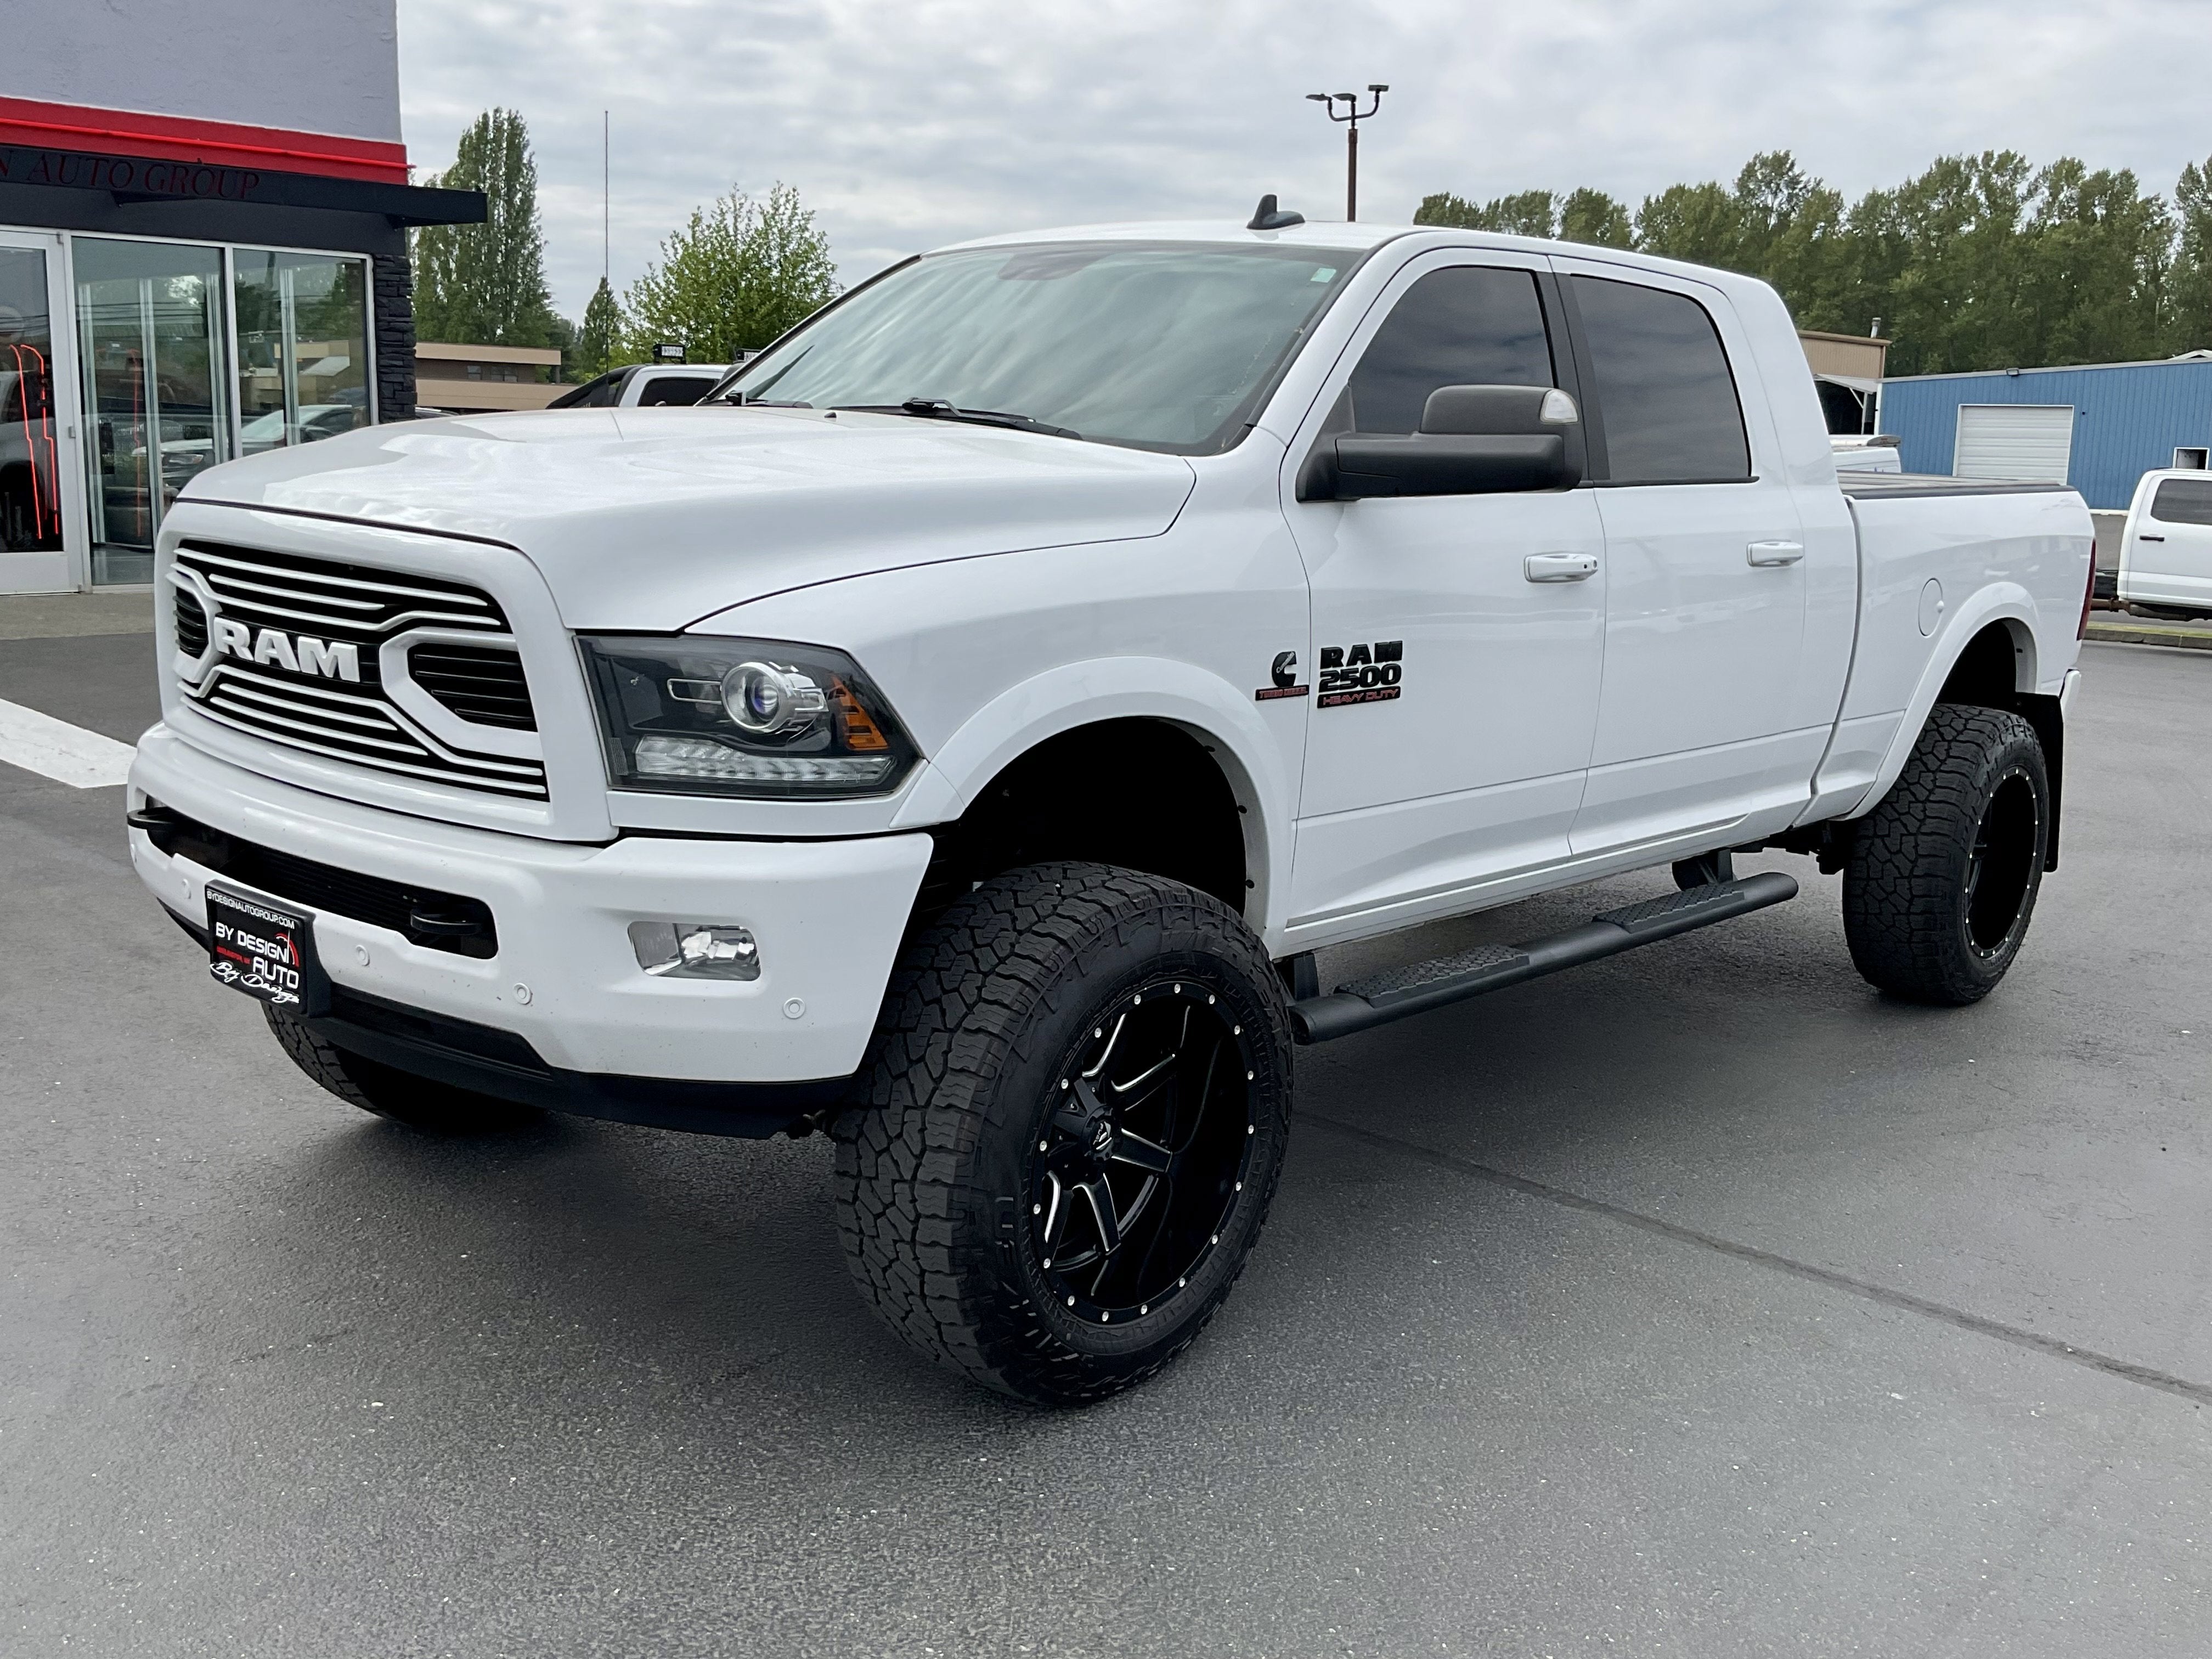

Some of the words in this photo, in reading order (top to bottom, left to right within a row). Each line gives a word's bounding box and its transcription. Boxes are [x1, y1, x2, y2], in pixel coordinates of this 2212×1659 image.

[25, 153, 135, 189] AUTO
[144, 165, 261, 199] GROUP
[213, 617, 360, 682] RAM
[1320, 640, 1403, 669] RAM
[1319, 663, 1402, 693] 2500
[1323, 692, 1364, 706] HEAVY
[1365, 689, 1399, 701] DUTY
[206, 890, 295, 930] BYDESIGNAUTOGROUP.COM
[216, 922, 234, 941] BY
[237, 930, 290, 964] DESIGN
[210, 961, 241, 983] By
[252, 956, 300, 989] AUTO
